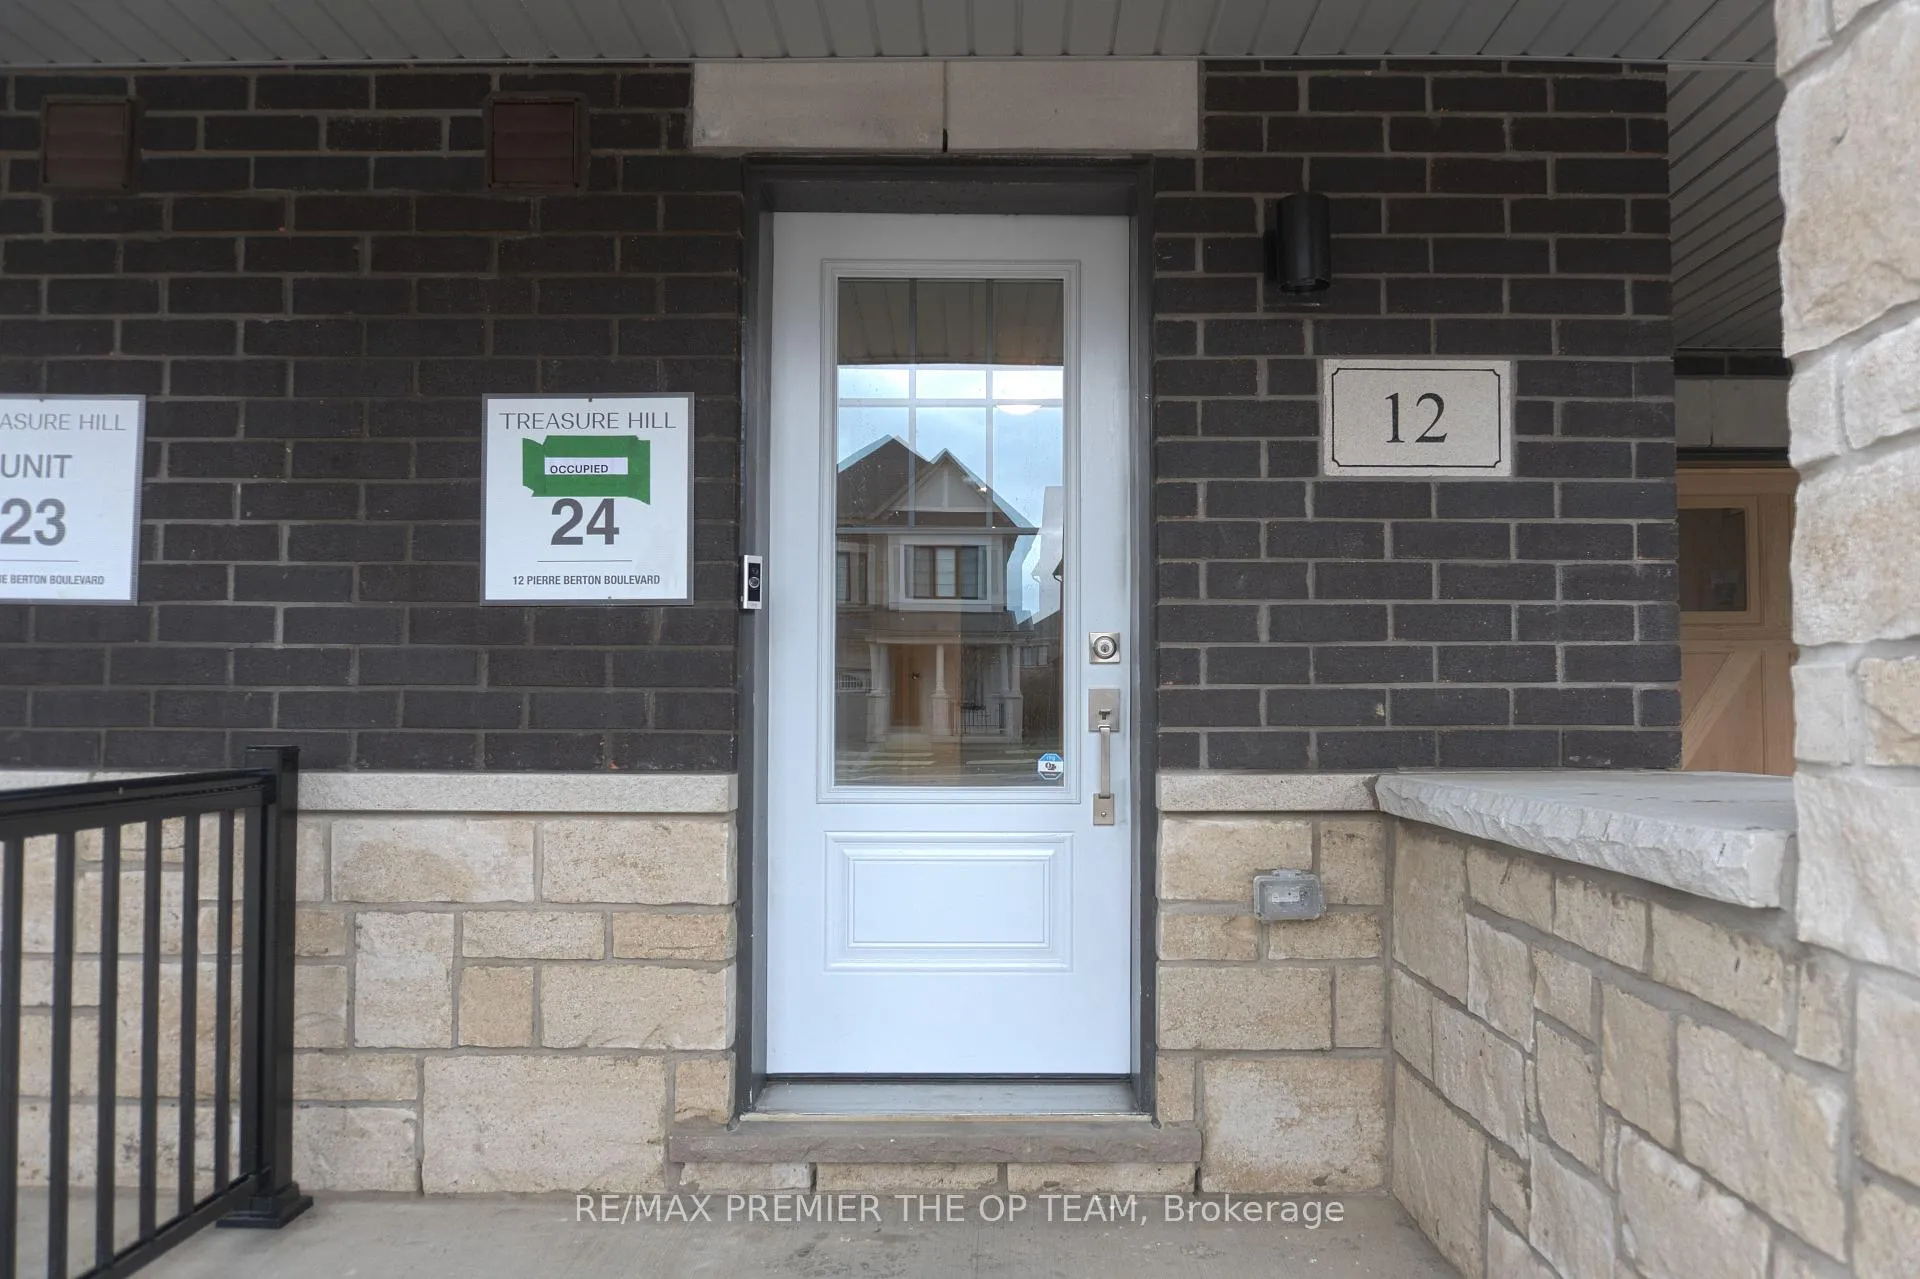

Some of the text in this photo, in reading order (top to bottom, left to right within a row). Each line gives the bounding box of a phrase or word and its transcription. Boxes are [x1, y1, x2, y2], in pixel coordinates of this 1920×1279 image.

[79, 414, 127, 431] HILL
[499, 411, 677, 430] TREASURE HILL
[1385, 392, 1448, 443] 12
[0, 454, 73, 479] UNIT
[549, 464, 609, 475] OCCUPIED
[0, 498, 67, 547] 23
[550, 498, 620, 546] 24
[10, 574, 47, 584] BERTON
[49, 575, 105, 586] BOULEVARD
[512, 574, 661, 586] 12 PIERRE BERTON BOULEVARD
